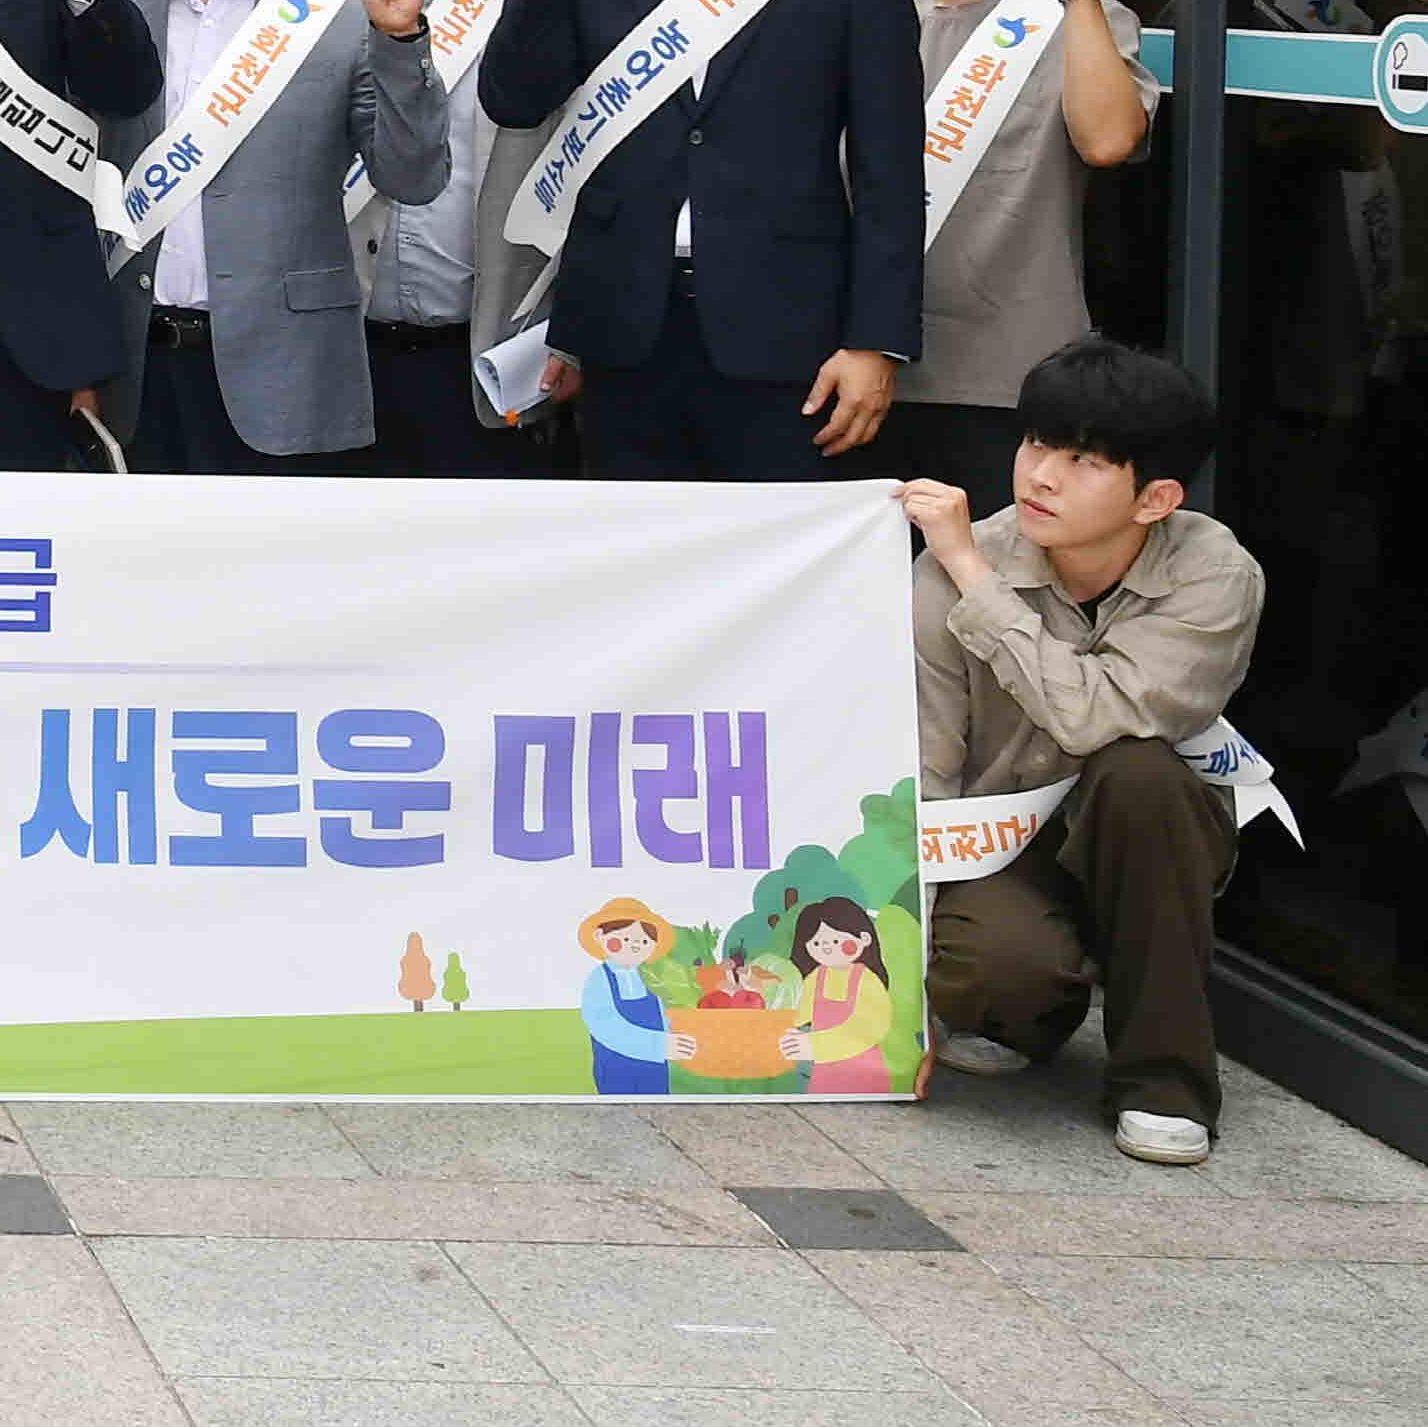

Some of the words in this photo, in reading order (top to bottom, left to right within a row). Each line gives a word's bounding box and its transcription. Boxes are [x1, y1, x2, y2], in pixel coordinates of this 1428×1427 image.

[206, 25, 291, 128] 화천군
[535, 19, 690, 213] 농어촌기본소득
[924, 53, 1008, 164] 화천군
[20, 708, 450, 867] 새로운
[494, 713, 778, 880] 미래
